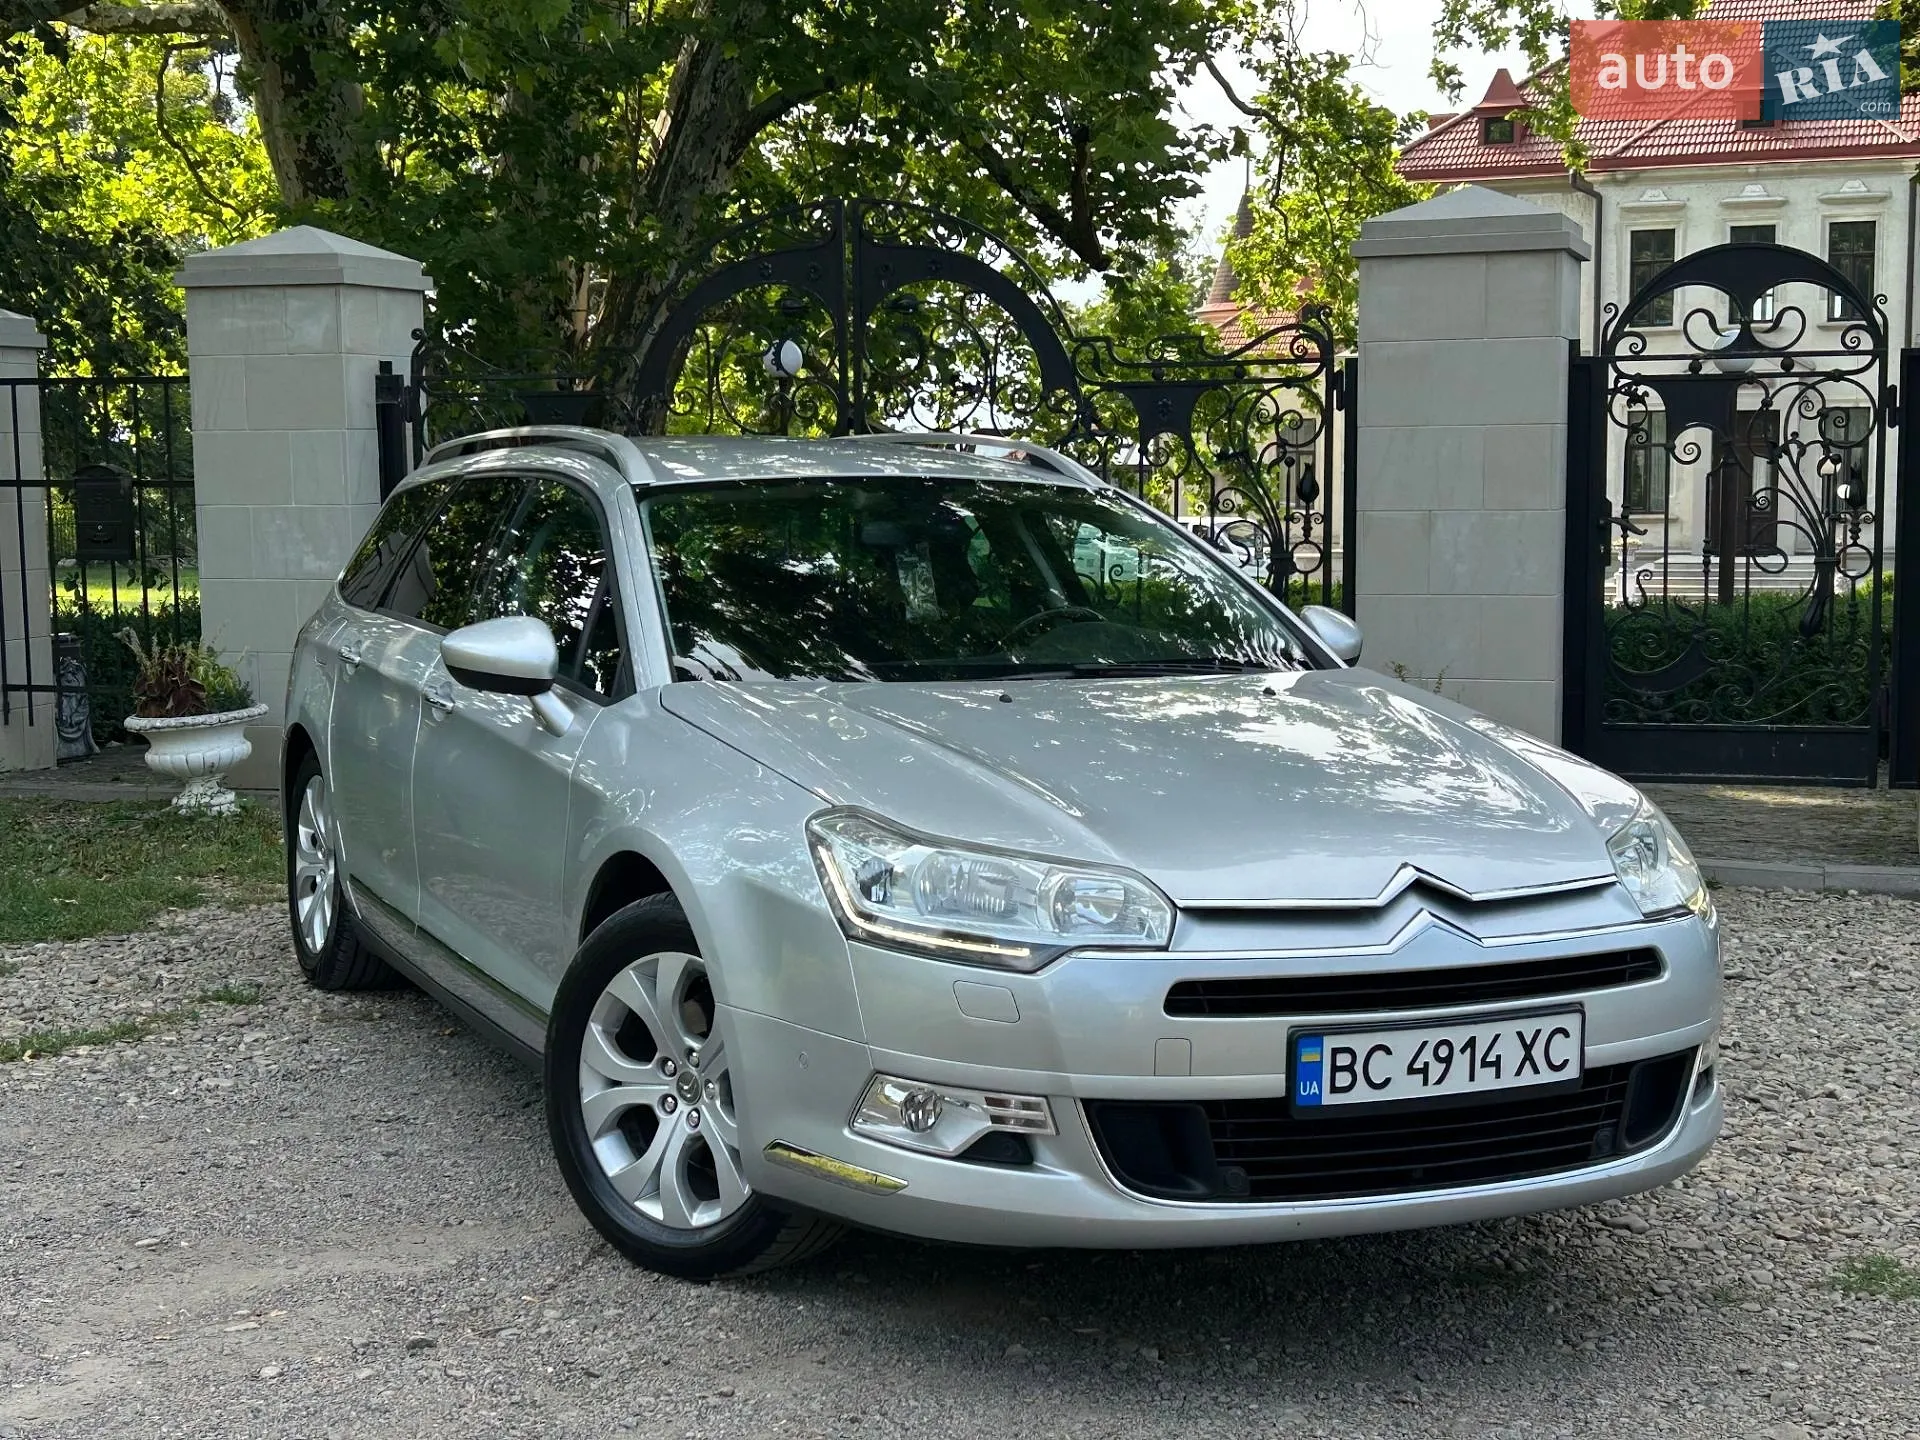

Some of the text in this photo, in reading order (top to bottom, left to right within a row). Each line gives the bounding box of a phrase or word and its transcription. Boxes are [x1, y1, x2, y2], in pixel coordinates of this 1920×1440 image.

[1328, 1026, 1571, 1095] BC 4914 XC
[1300, 1080, 1320, 1096] UA
